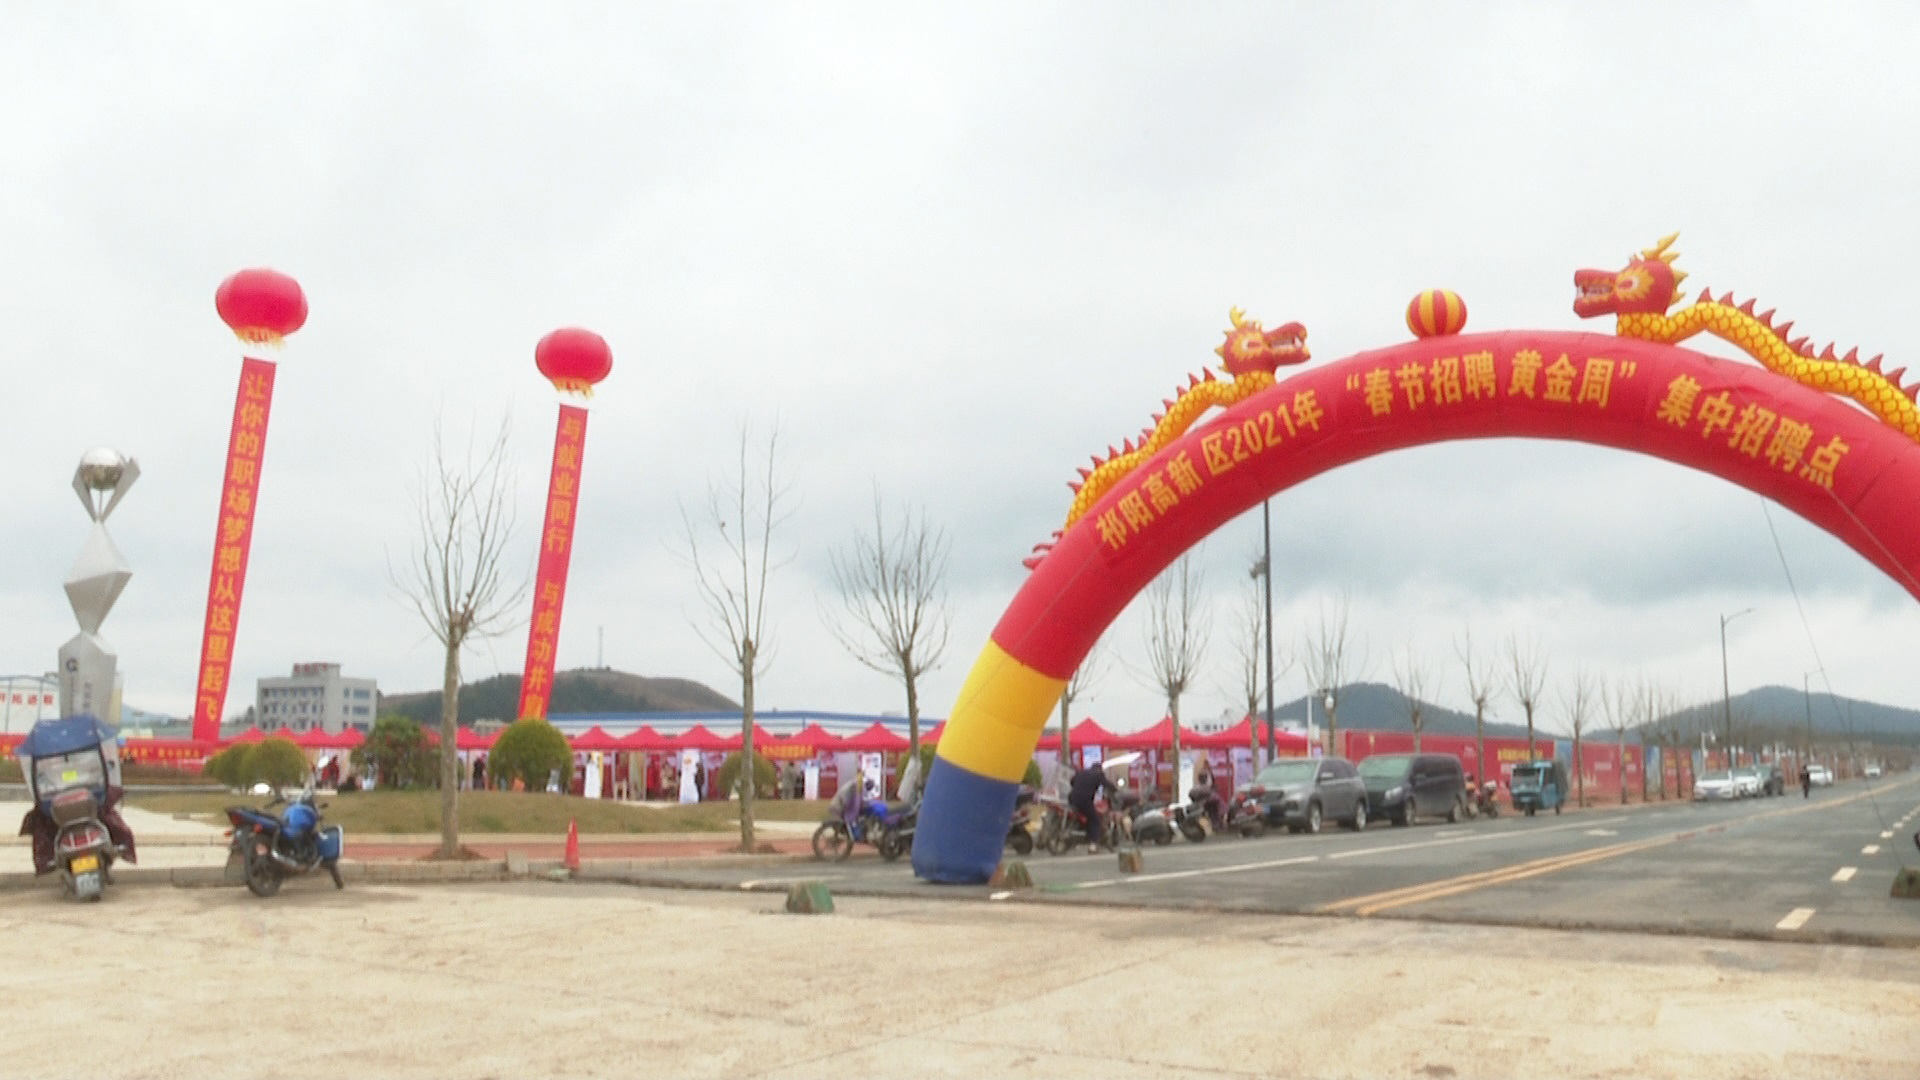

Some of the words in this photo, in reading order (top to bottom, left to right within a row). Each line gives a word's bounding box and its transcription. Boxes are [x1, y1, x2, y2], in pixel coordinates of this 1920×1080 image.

[547, 415, 581, 554] 与就业同行
[1656, 373, 1850, 489] 集中招聘点
[200, 372, 266, 721] 让你的职场梦想从这里起飞
